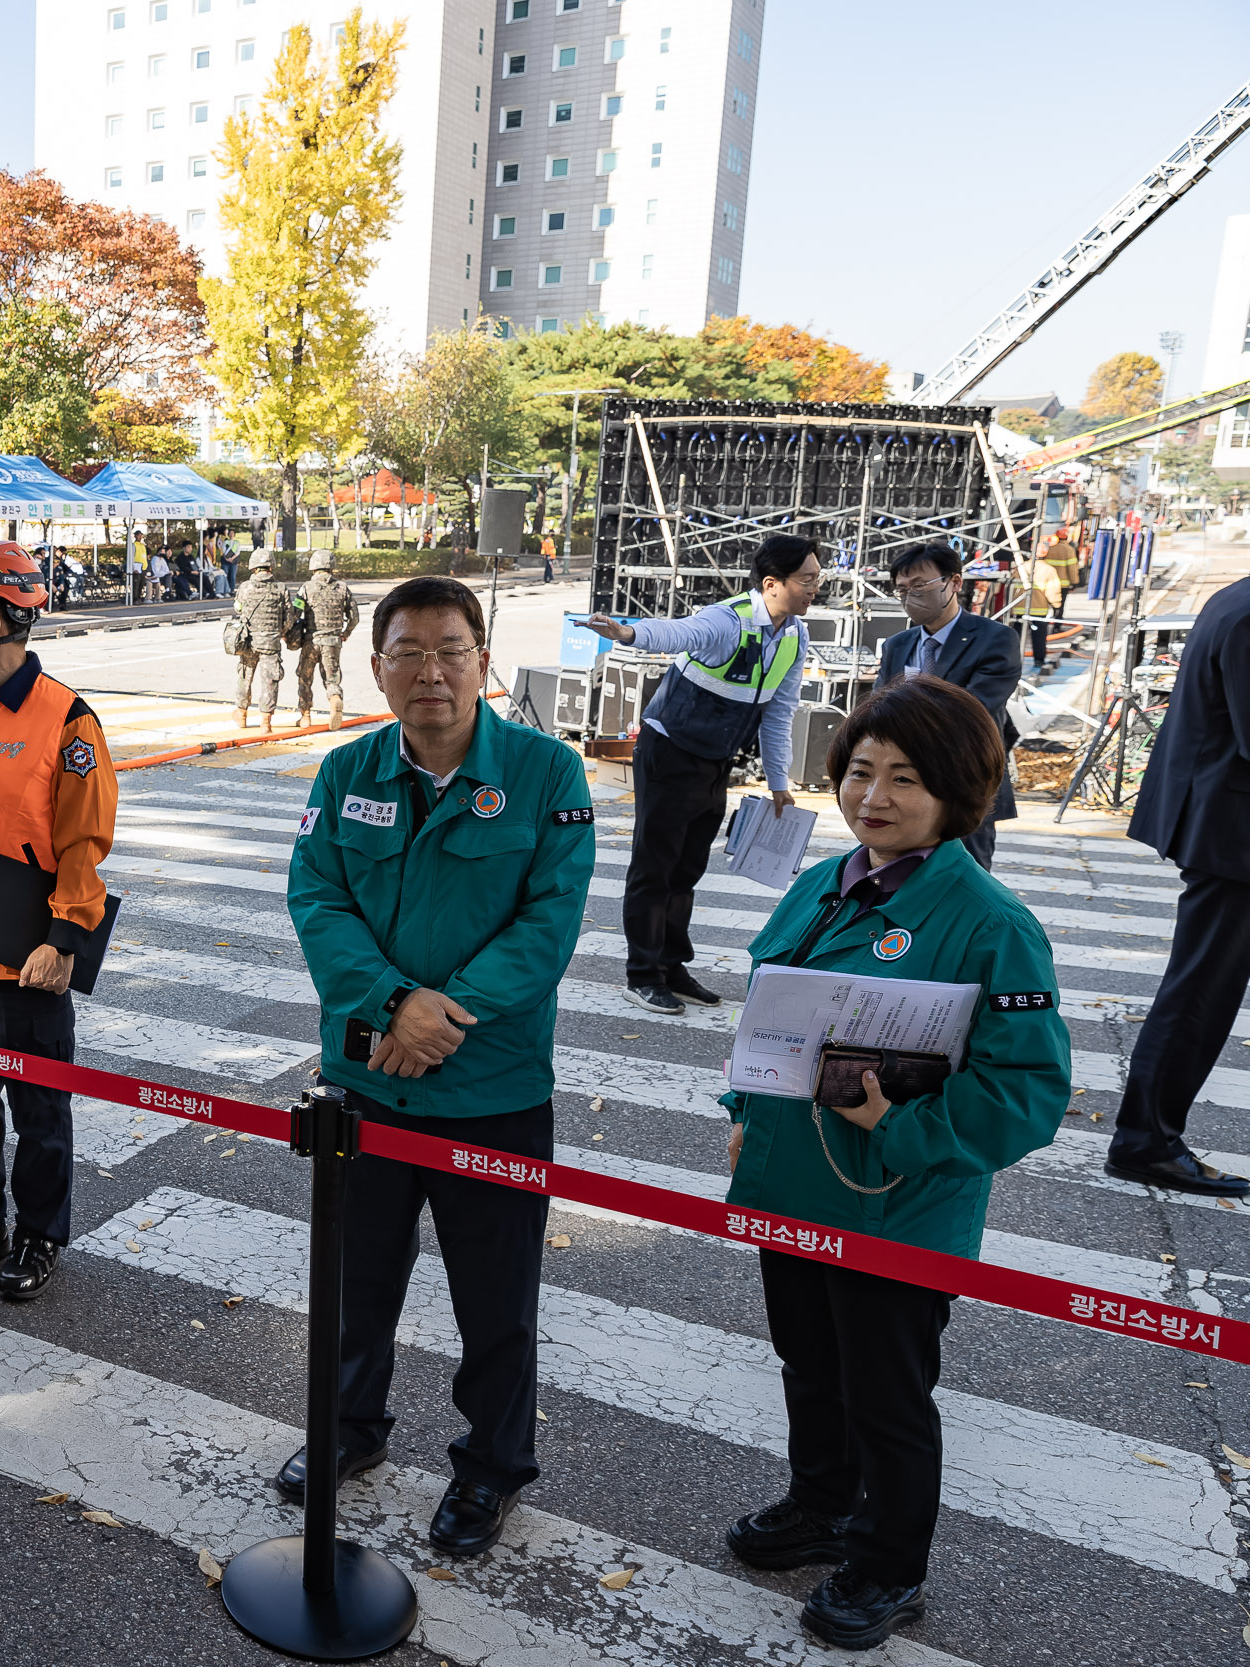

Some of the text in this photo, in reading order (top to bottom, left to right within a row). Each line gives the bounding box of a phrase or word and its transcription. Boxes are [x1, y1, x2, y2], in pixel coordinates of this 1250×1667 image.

[1, 505, 21, 515] 광진구
[27, 504, 53, 517] 안전
[63, 504, 86, 517] 한국
[95, 504, 117, 517] 훈련
[558, 809, 591, 822] 광진구
[997, 994, 1046, 1007] 광진구
[752, 1031, 783, 1043] 시나리오
[138, 1086, 213, 1119] 광진소방서
[451, 1148, 547, 1188] 광진소방서
[725, 1212, 843, 1259] 광진소방서
[1068, 1292, 1221, 1350] 광진소방서
